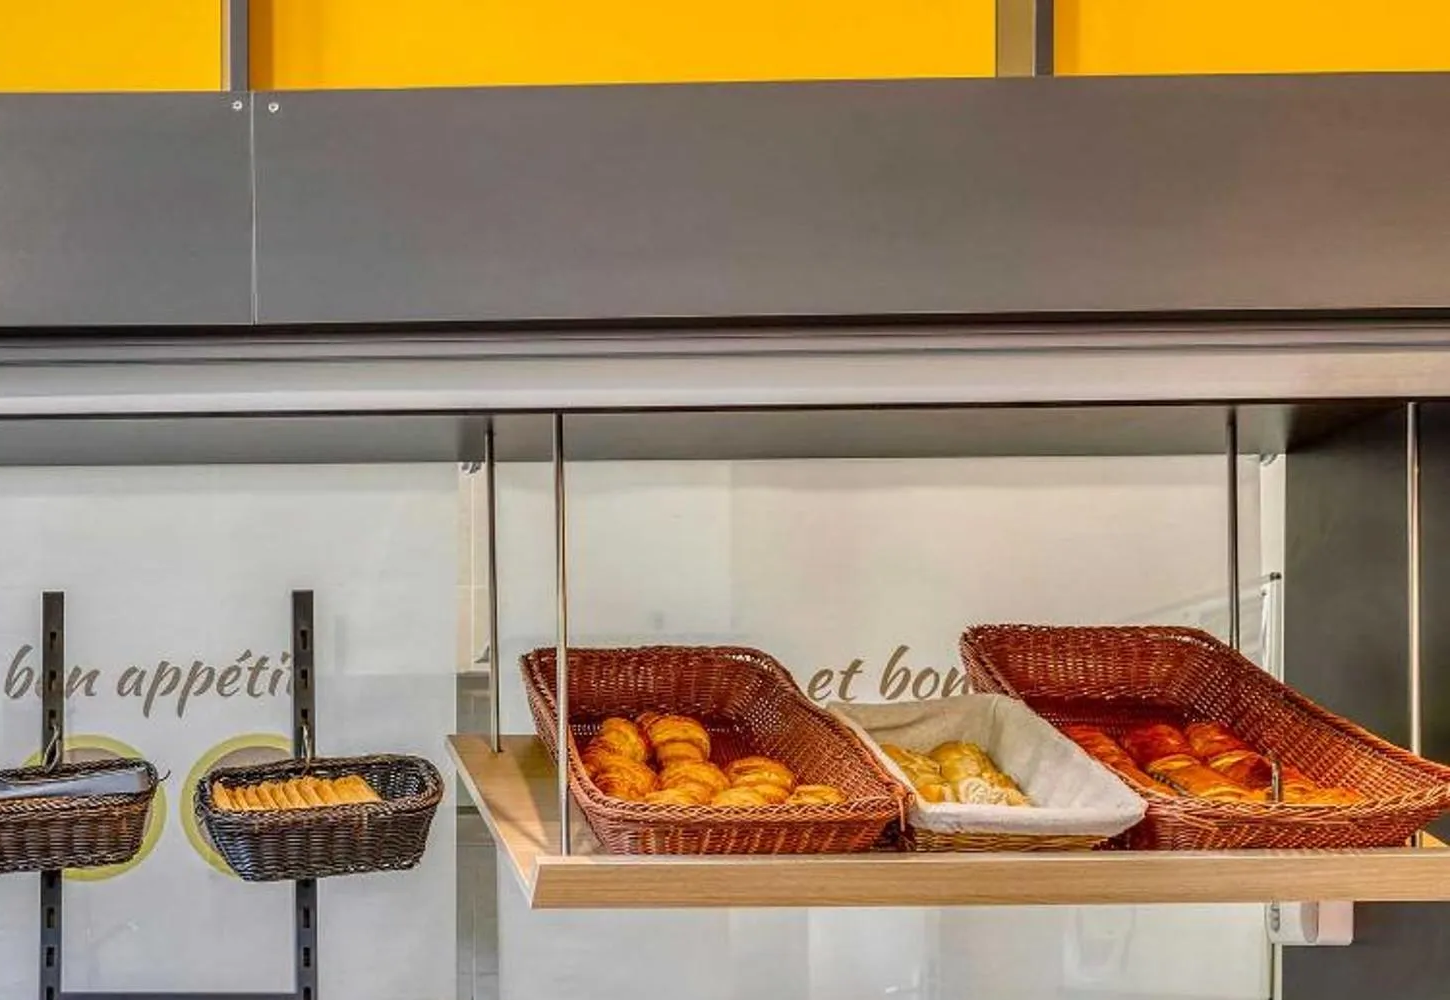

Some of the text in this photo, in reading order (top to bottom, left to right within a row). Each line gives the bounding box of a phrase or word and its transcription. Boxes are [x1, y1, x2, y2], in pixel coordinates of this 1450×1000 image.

[4, 644, 101, 699] bn
[116, 649, 294, 719] appéti
[807, 644, 969, 701] et bon
